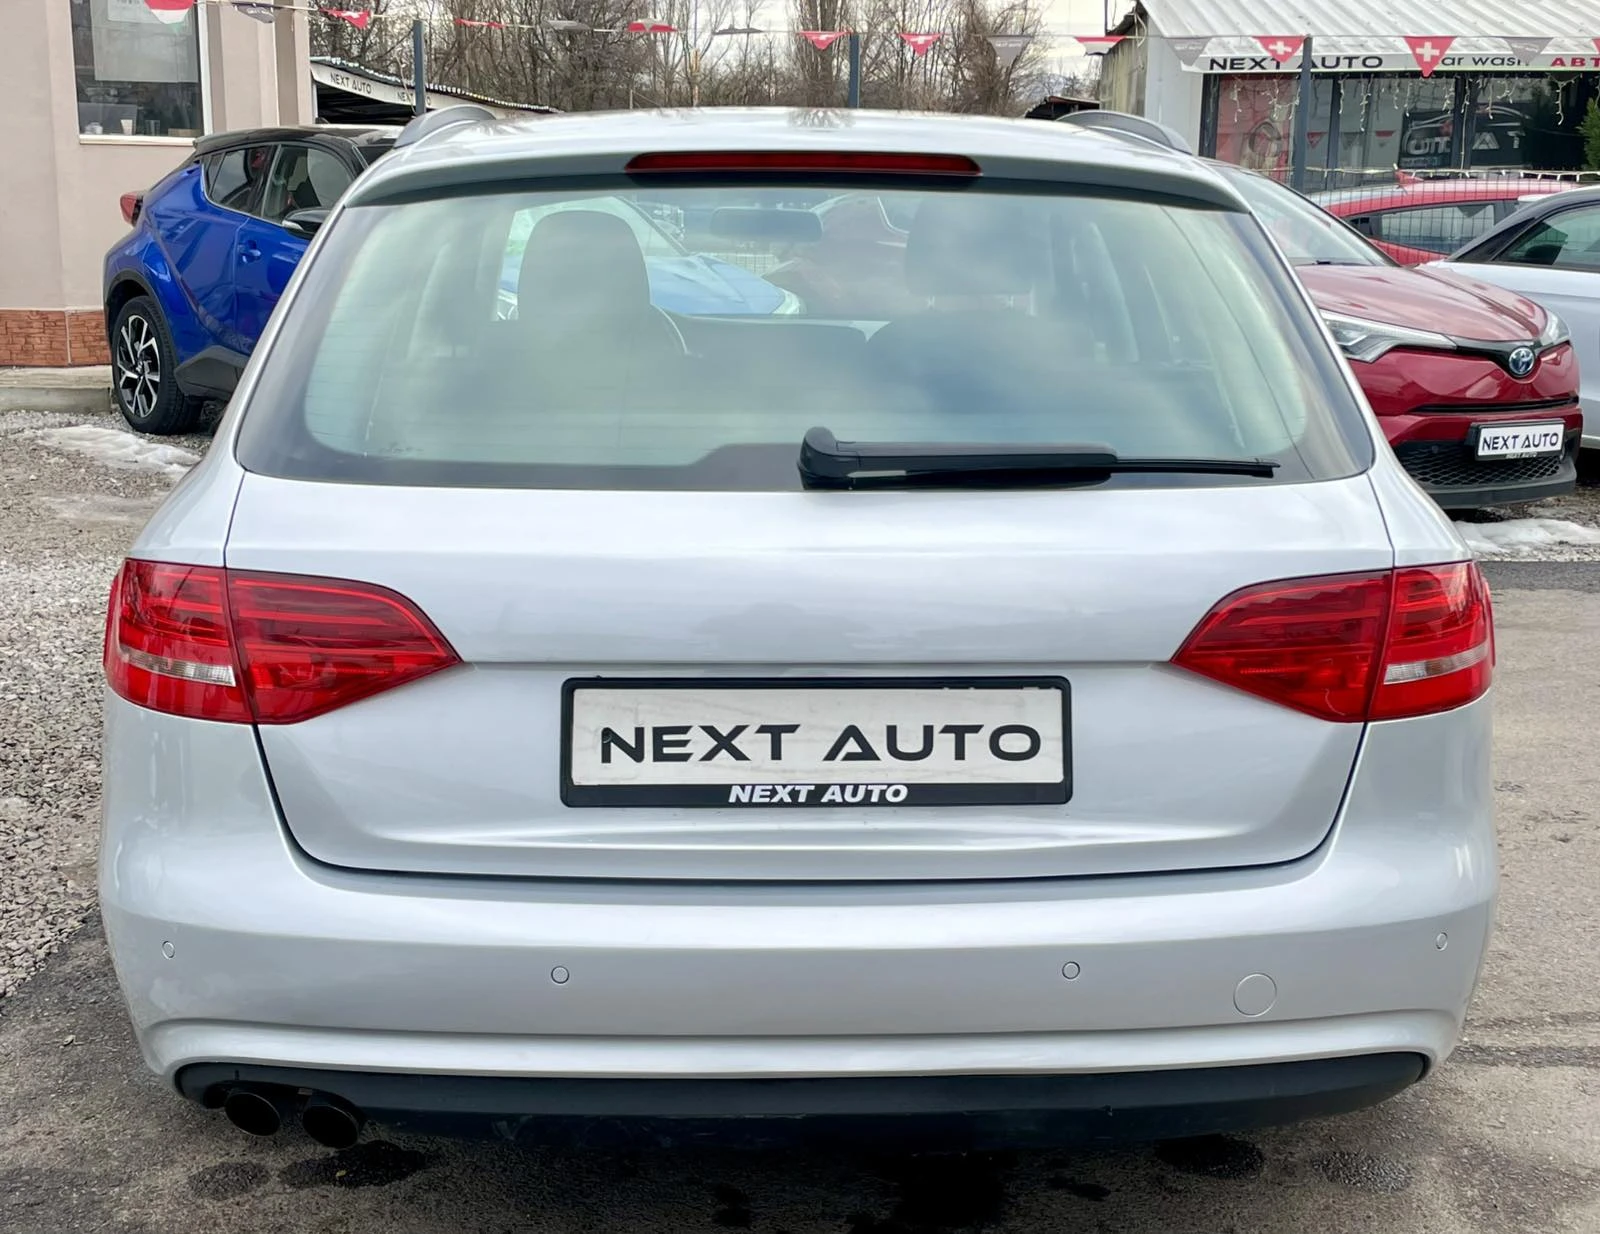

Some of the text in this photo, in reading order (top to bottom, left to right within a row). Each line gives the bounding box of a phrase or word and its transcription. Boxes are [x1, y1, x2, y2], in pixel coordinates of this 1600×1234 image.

[1441, 56, 1464, 66] ar
[330, 72, 372, 94] NEXT AUTO
[1482, 432, 1559, 451] NEXT AUTO
[601, 724, 1042, 763] NEXT AUTO
[728, 785, 908, 803] NEXT AUTO
